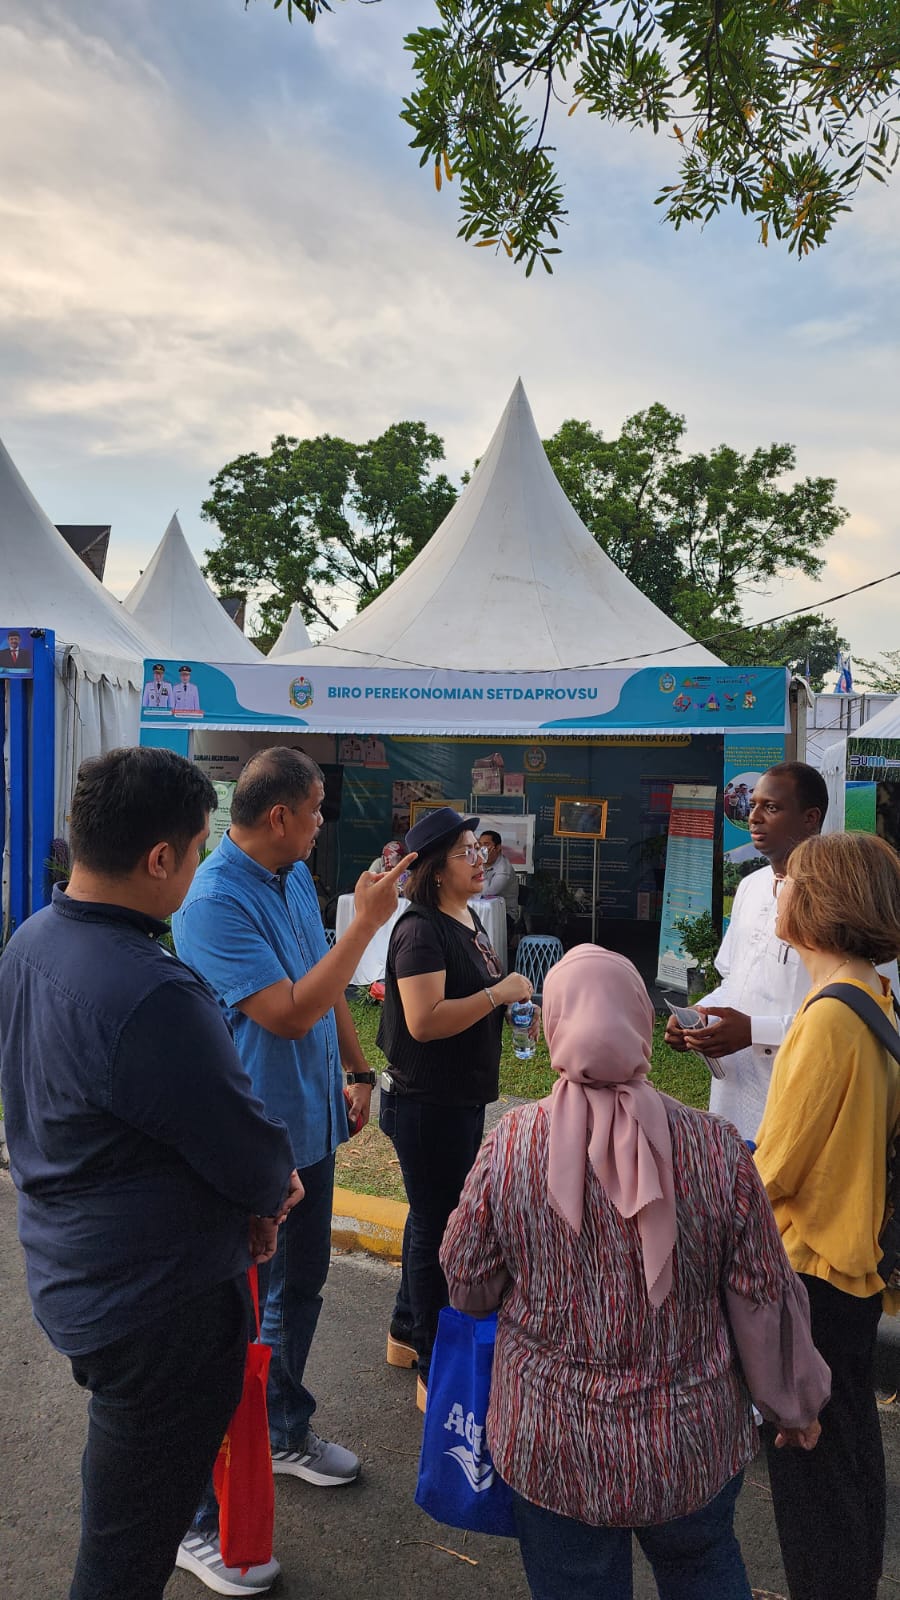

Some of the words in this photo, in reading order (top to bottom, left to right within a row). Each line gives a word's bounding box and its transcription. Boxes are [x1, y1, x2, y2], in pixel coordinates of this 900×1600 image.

[327, 686, 361, 699] BIRO
[364, 687, 484, 700] PEREKONOMIAN
[486, 687, 598, 700] SETDAPROVSU
[659, 735, 690, 743] UTARA
